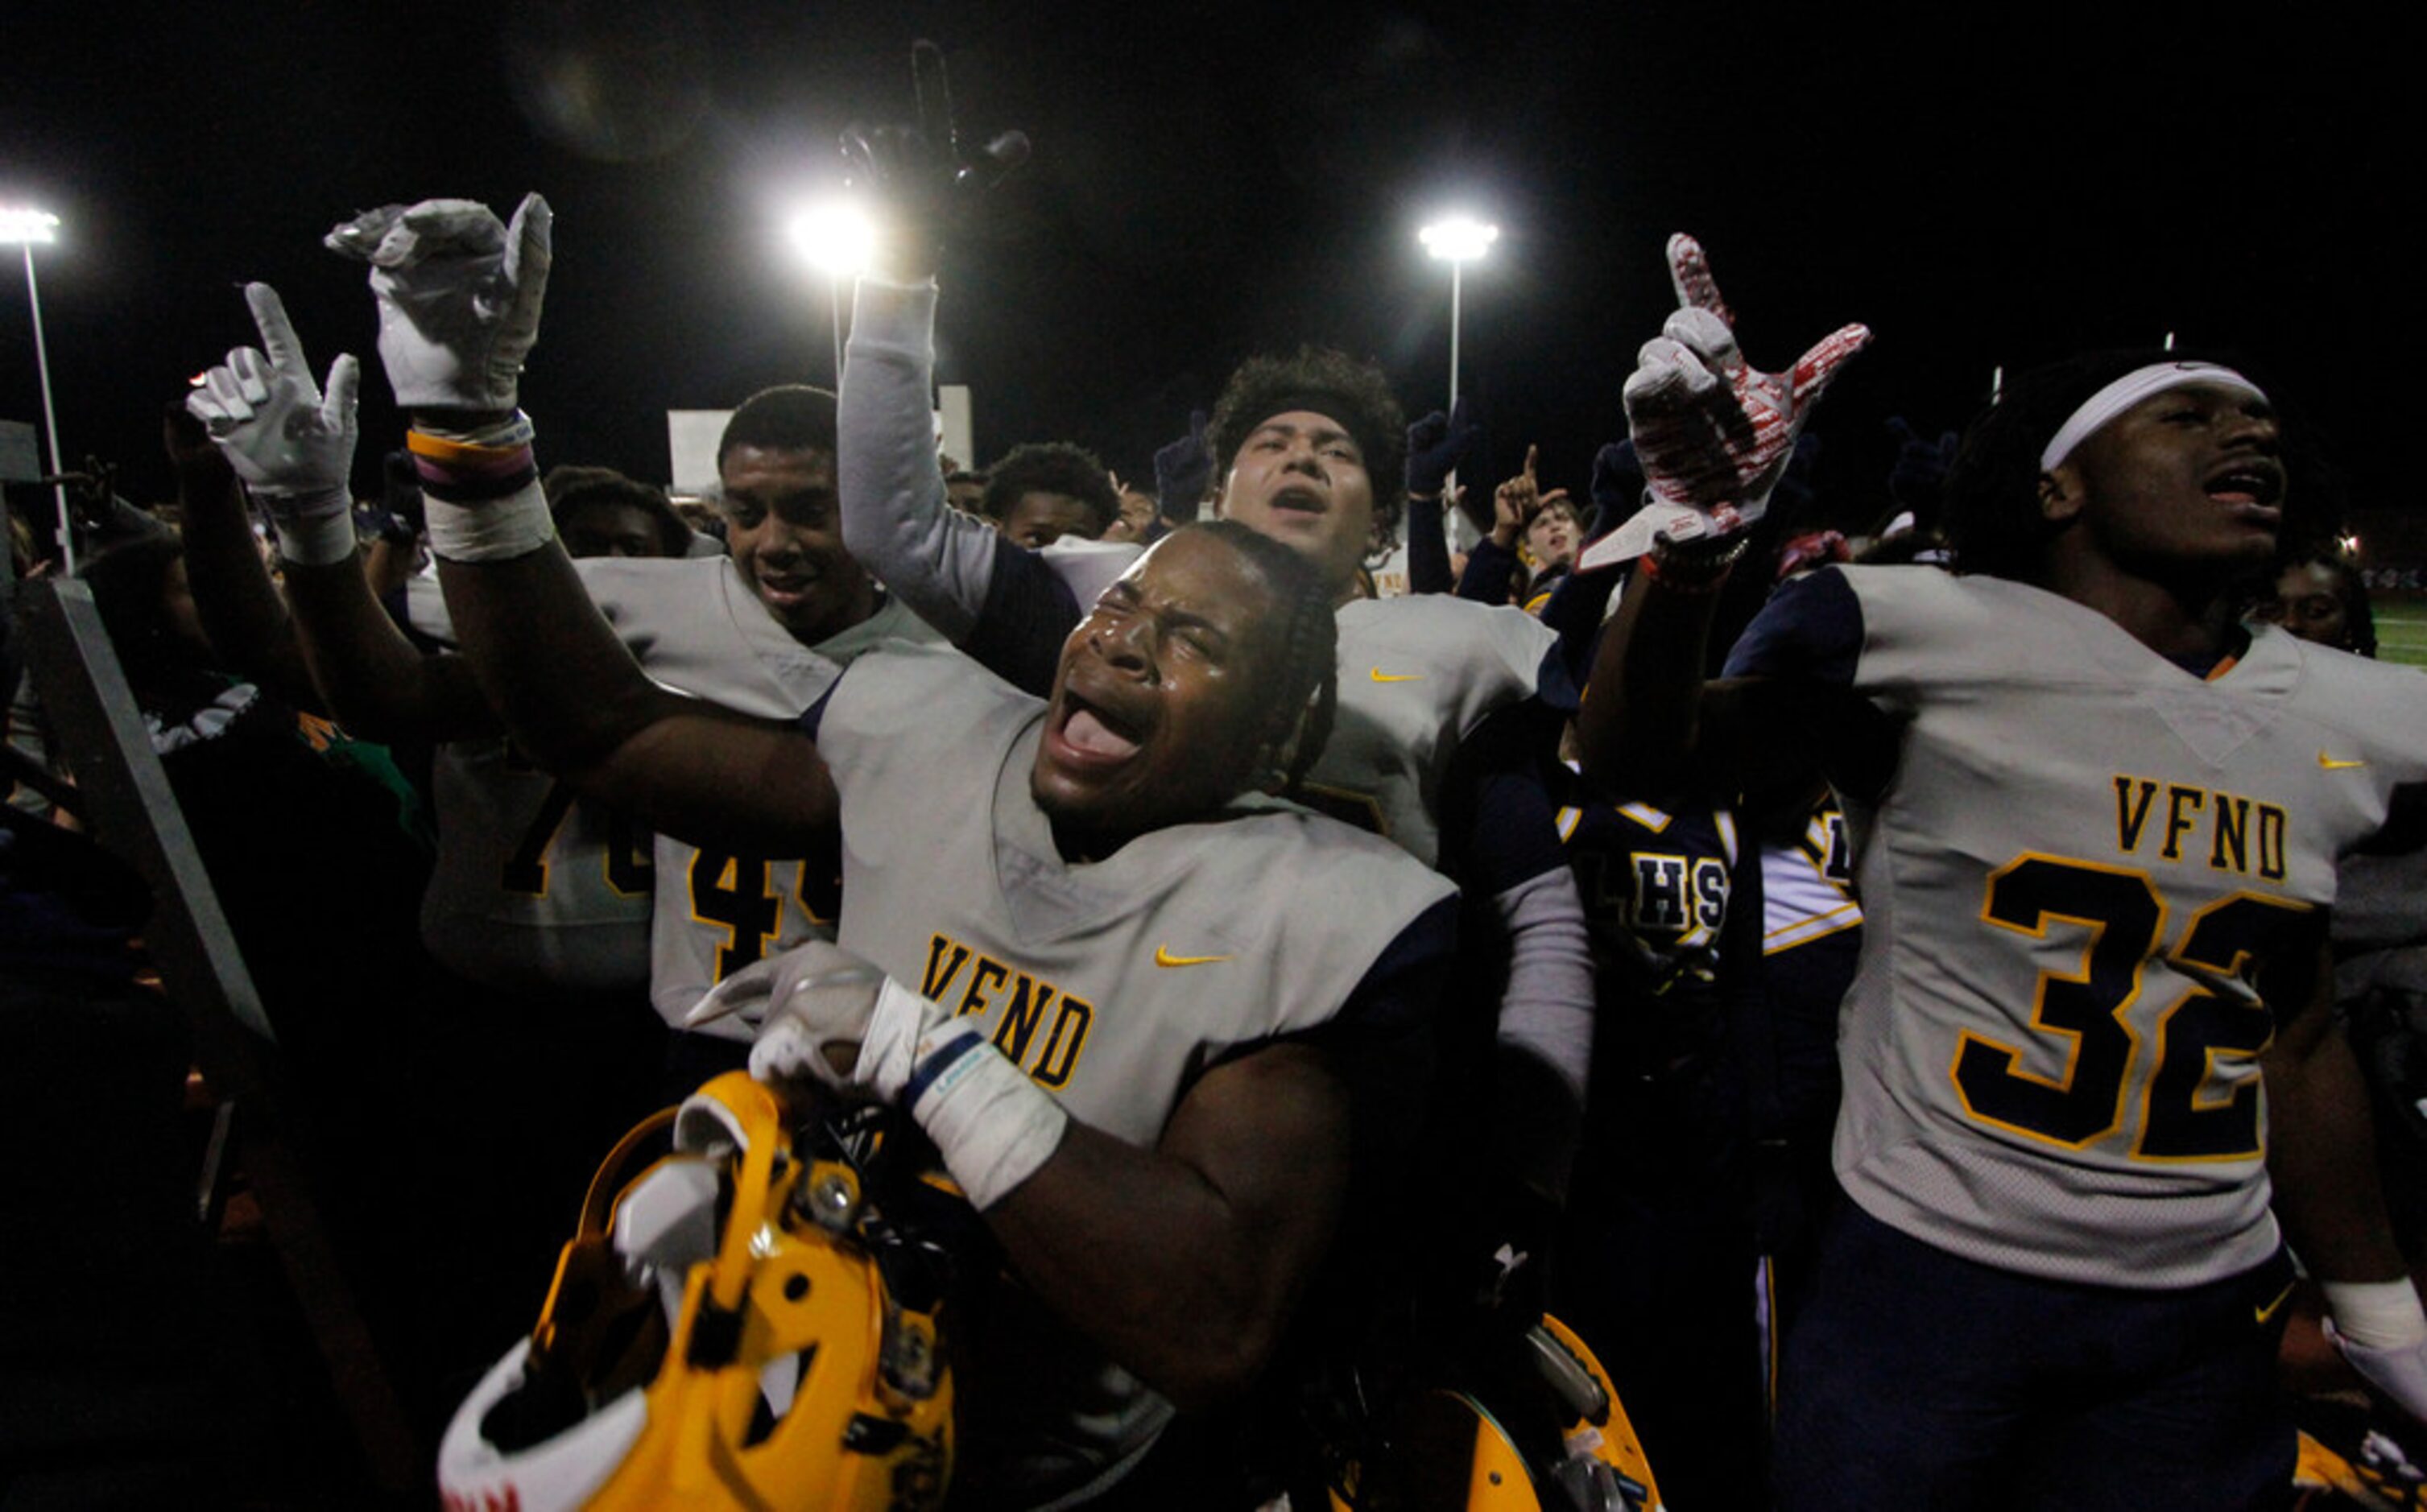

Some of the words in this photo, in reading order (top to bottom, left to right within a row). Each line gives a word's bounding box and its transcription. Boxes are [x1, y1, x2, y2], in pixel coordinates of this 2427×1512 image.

[2115, 775, 2289, 881] VFND
[921, 932, 1095, 1093] VFND
[1949, 850, 2317, 1163] 32
